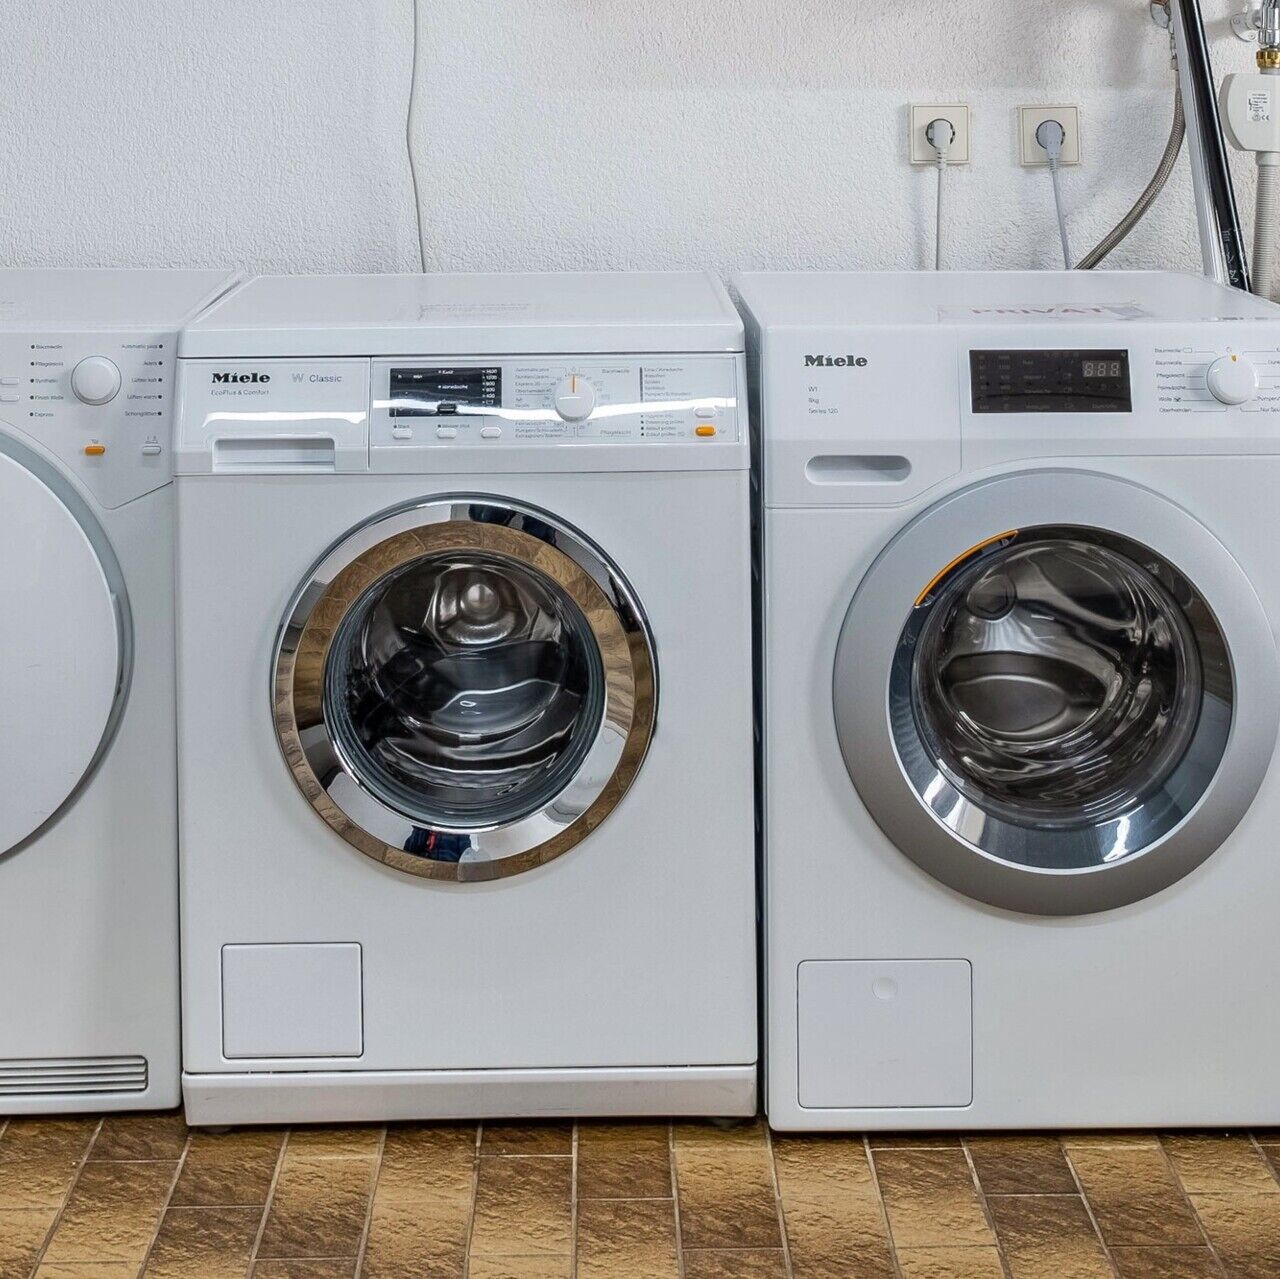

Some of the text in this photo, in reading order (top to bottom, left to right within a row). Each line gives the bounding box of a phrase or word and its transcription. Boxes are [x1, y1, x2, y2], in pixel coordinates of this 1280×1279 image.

[804, 355, 867, 367] Miele
[212, 373, 270, 383] Miele
[292, 373, 342, 383] W Classic
